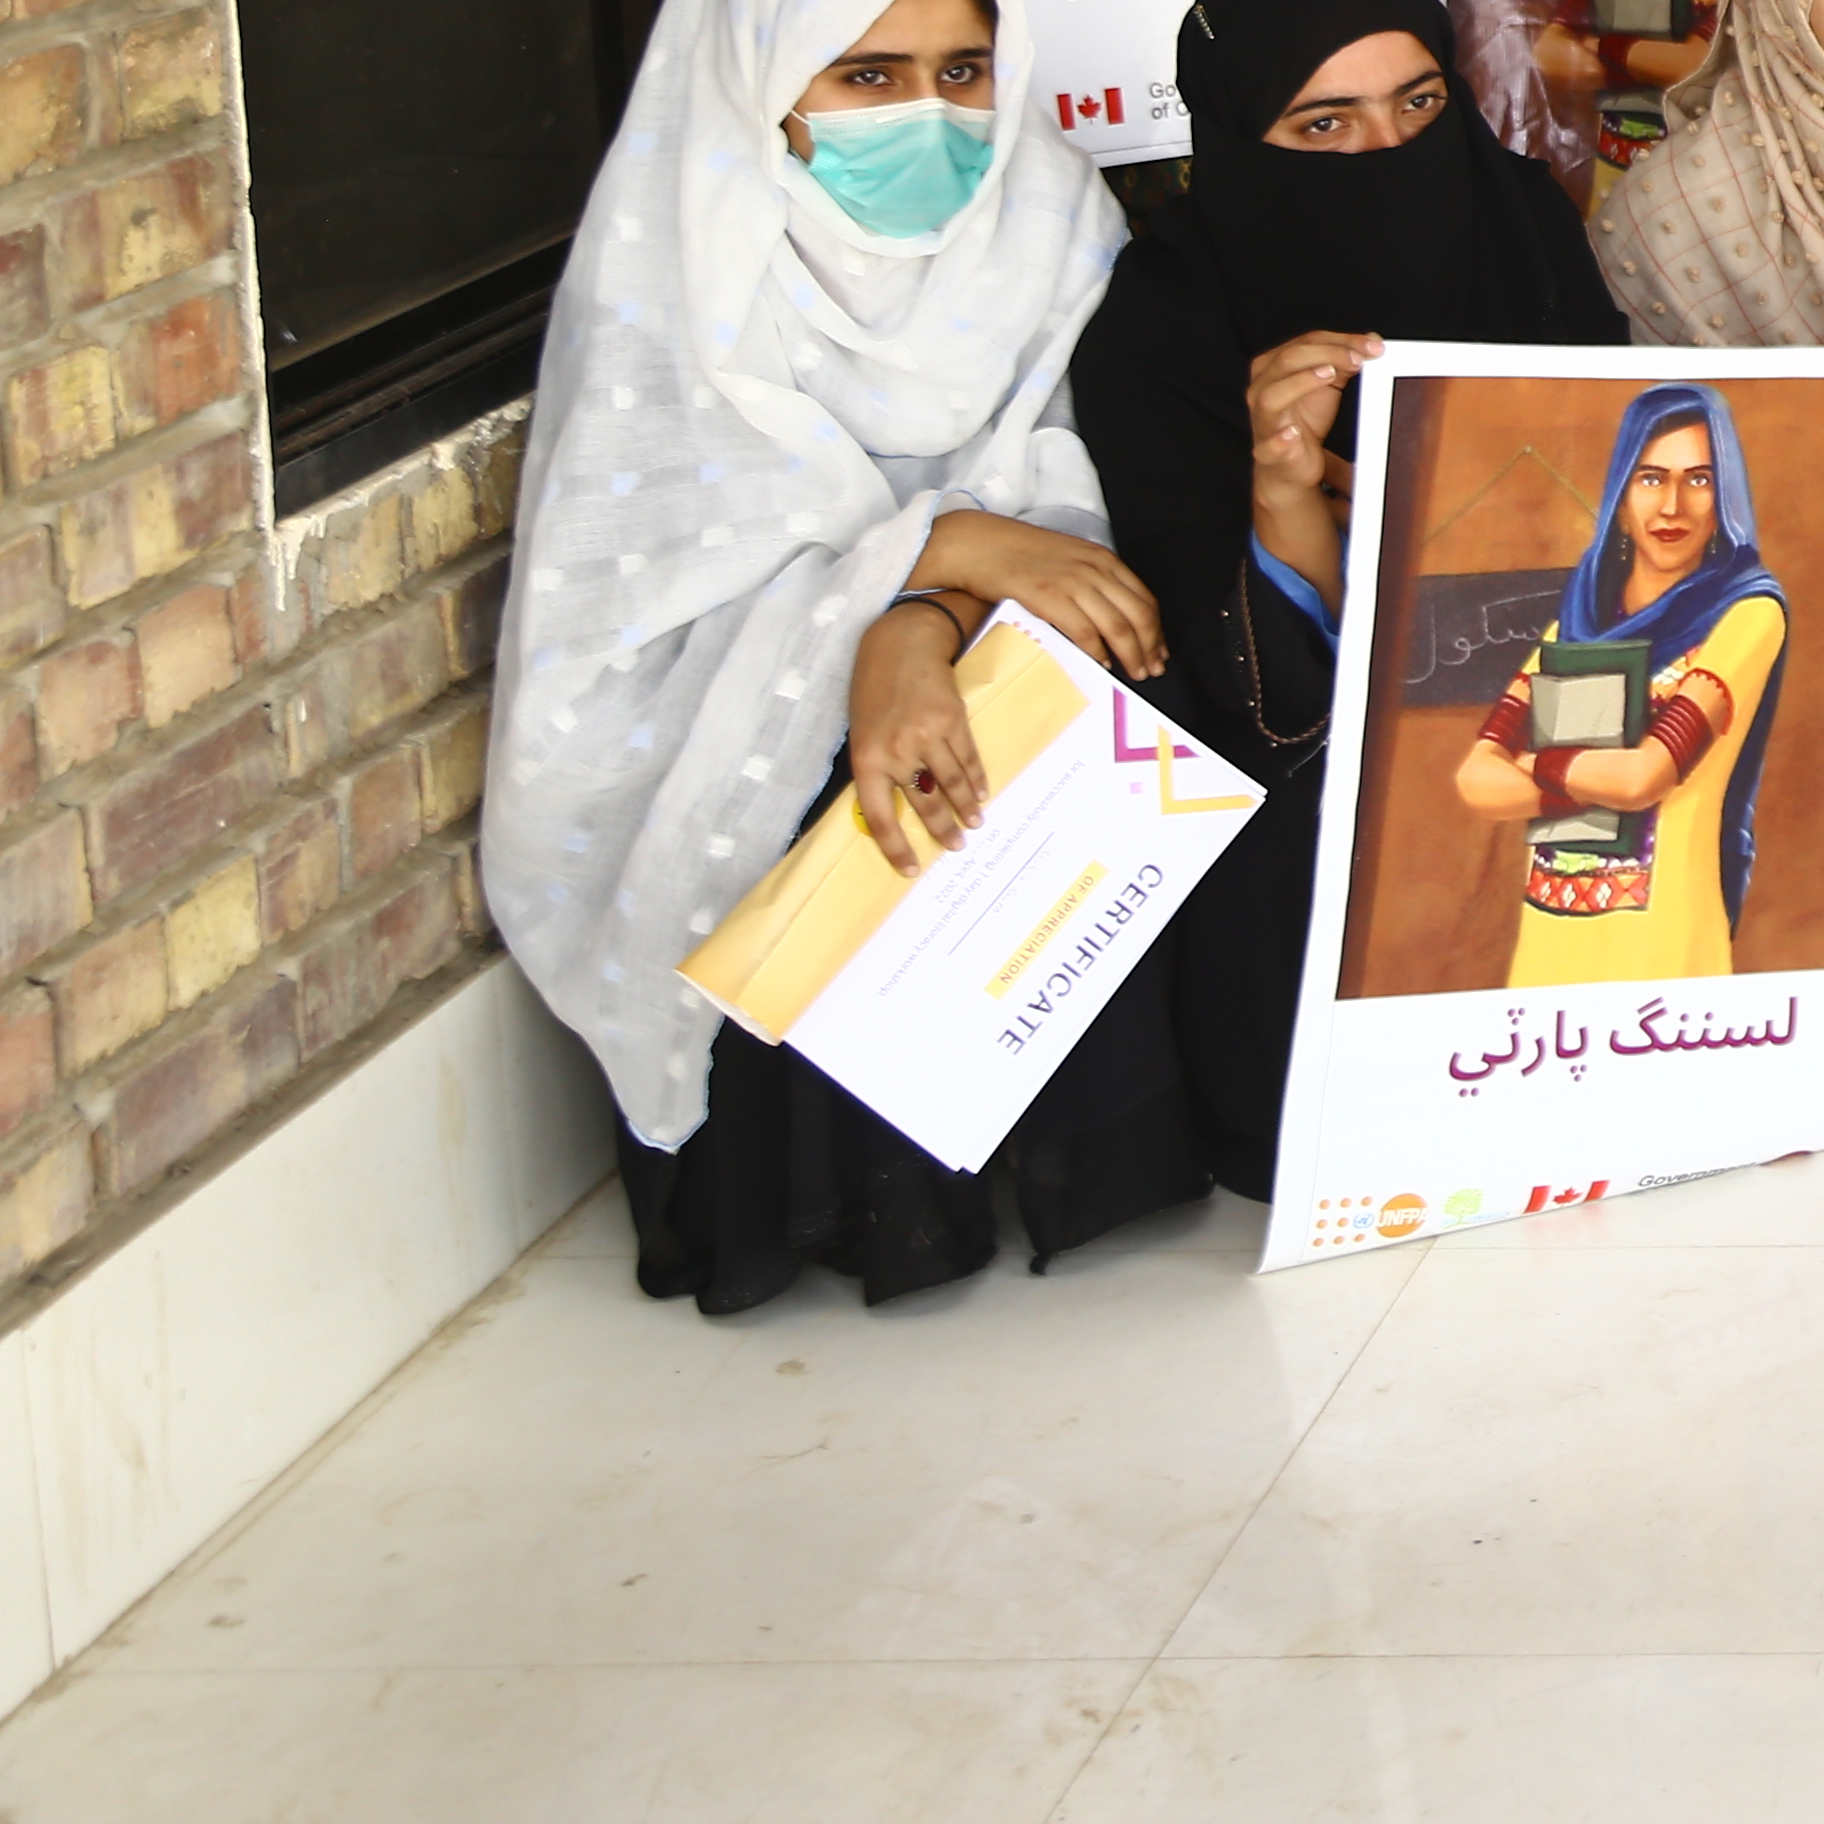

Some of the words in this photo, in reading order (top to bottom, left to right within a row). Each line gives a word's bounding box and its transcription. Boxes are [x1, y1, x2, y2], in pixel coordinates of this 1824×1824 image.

[1151, 102, 1169, 120] of
[934, 877, 959, 904] 2022
[1075, 873, 1095, 895] OF
[998, 892, 1079, 985] APPRECIATION
[995, 859, 1167, 1056] CERTIFICATE
[876, 949, 921, 999] workshop
[1377, 1207, 1428, 1227] UNFPA
